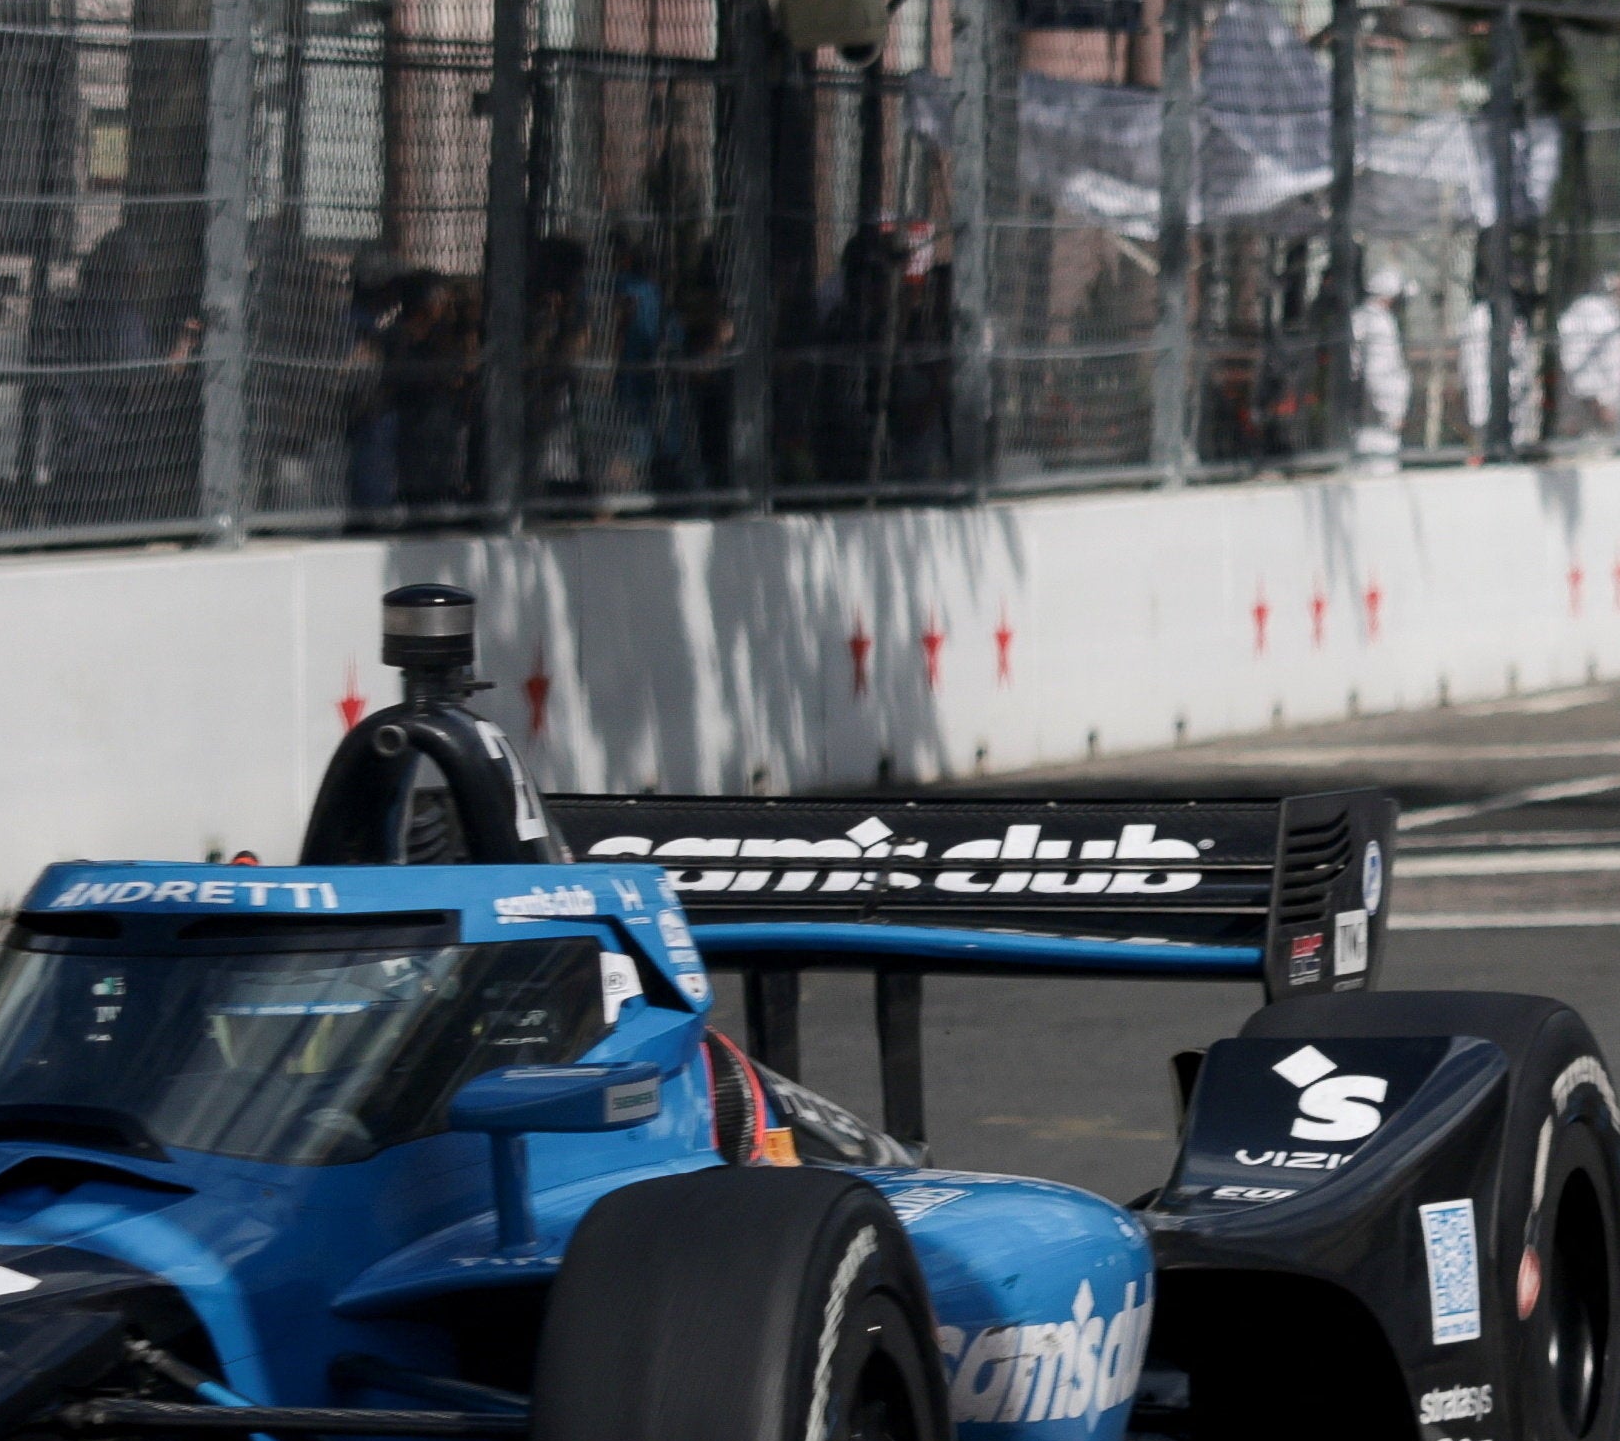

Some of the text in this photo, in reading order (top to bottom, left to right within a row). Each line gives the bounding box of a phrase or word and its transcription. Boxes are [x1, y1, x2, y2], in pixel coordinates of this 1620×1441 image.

[935, 823, 1203, 894] club
[51, 880, 338, 909] ANDRETTI
[1234, 1148, 1355, 1170] VIZI
